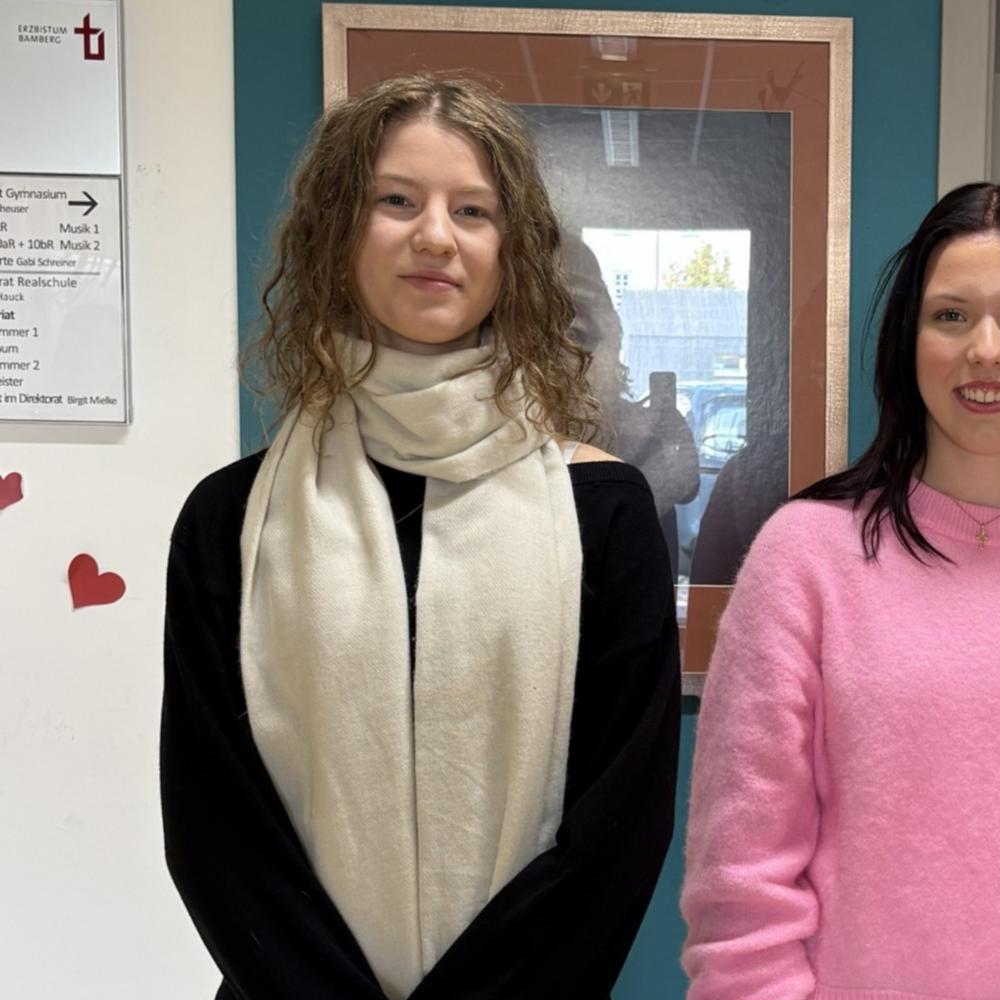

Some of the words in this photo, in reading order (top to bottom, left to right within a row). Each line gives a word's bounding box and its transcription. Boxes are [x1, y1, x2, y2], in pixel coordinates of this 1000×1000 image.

[18, 24, 68, 35] ERZBISTUM
[18, 34, 62, 44] BAMBERG
[6, 187, 67, 201] Gymnasium
[59, 223, 91, 234] Musik
[93, 223, 100, 234] 1
[28, 239, 54, 250] 10bR
[60, 239, 91, 251] Musik
[93, 240, 100, 251] 2
[17, 276, 78, 289] Realschule
[32, 327, 39, 338] 1
[33, 360, 40, 371] 2
[19, 393, 63, 405] Direktorat
